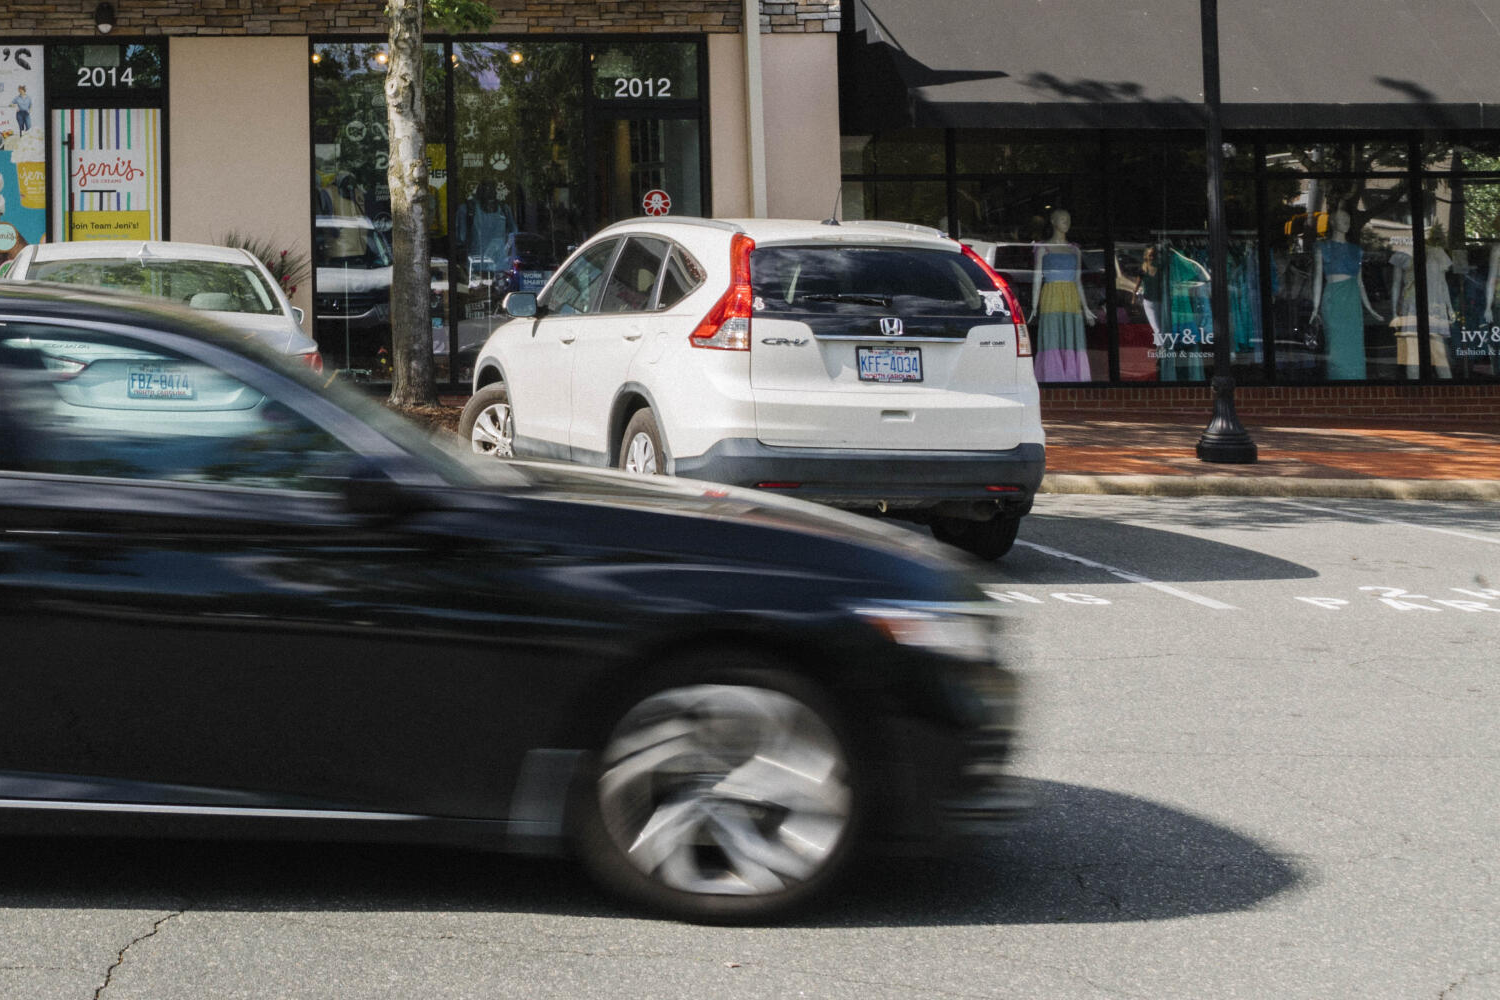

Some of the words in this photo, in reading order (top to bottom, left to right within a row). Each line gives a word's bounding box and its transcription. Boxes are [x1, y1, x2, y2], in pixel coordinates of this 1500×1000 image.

[77, 67, 134, 87] 2014
[614, 78, 671, 97] 2012
[72, 157, 144, 187] jeni's
[90, 222, 112, 230] Team
[114, 221, 139, 230] Jeni's!
[1152, 332, 1180, 349] ivy
[1182, 328, 1197, 344] &
[1199, 328, 1214, 344] le
[1461, 326, 1488, 347] ivy
[1147, 350, 1177, 358] fashion
[1456, 347, 1486, 356] fashion
[860, 355, 918, 373] KFF-4034
[131, 373, 189, 390] FBZ-8474
[1357, 585, 1429, 598] 2
